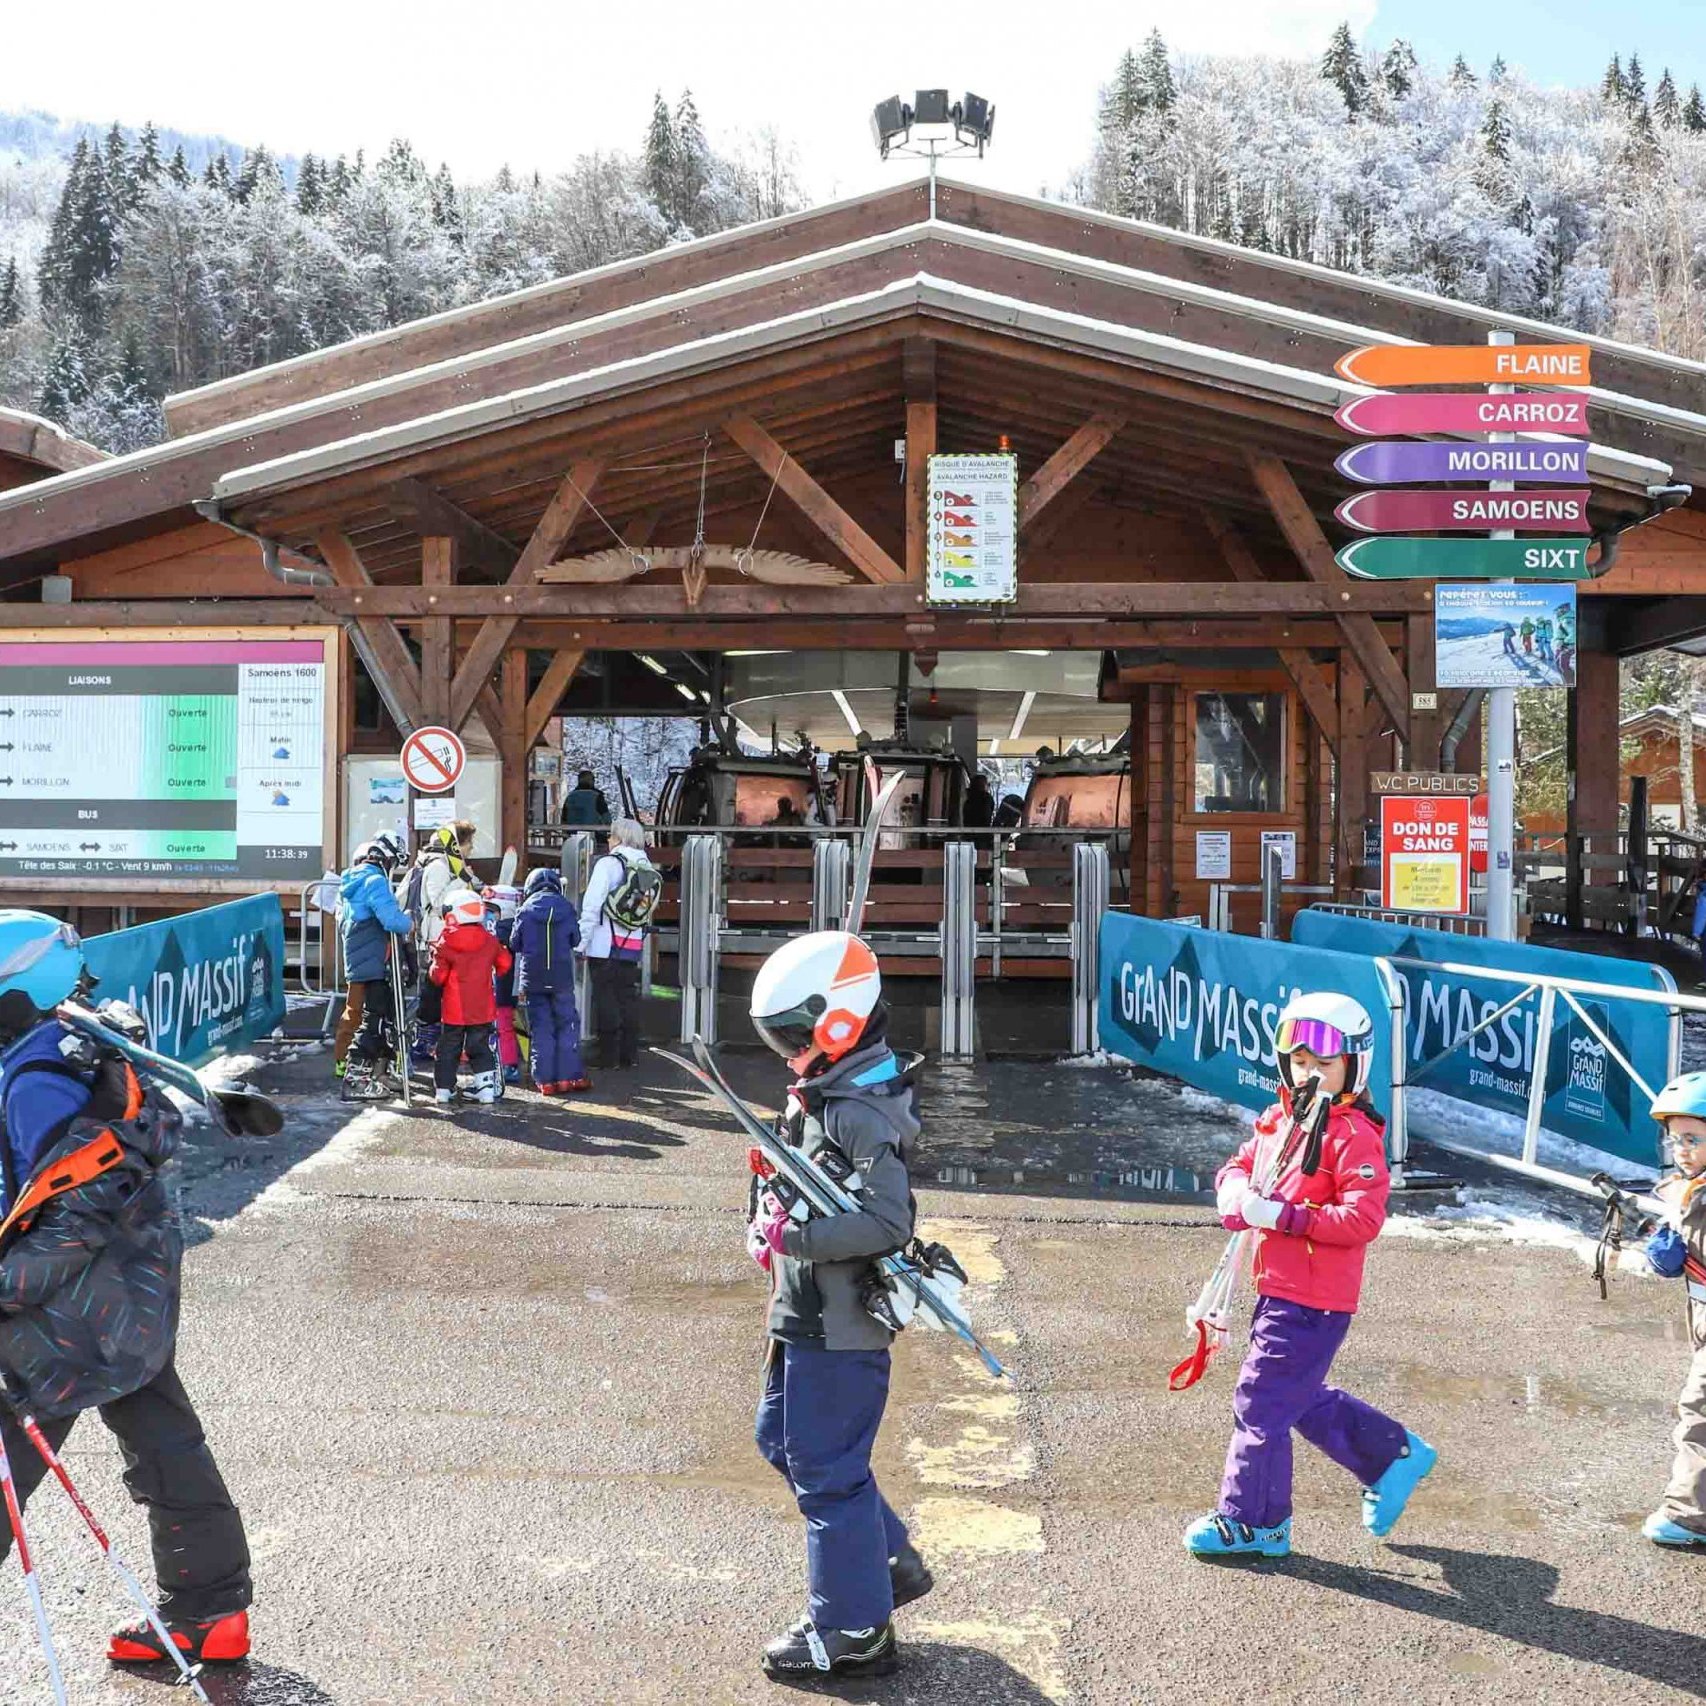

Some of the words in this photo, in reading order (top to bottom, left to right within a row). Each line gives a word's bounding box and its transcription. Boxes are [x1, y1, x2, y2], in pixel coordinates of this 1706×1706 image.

[1496, 354, 1582, 375] FLAINE
[1478, 403, 1580, 423] CARROZ
[1449, 451, 1580, 472] MORILLON
[1453, 499, 1580, 520] SAMOENS
[1524, 549, 1580, 569] SIXT
[295, 668, 317, 678] 1600
[68, 675, 112, 685] LIAISONS
[168, 708, 207, 718] Ouverte
[168, 743, 207, 753] Ouverte
[167, 777, 207, 787] Ouverte
[1376, 776, 1402, 790] WC
[1407, 776, 1479, 791] PUBLICS
[77, 809, 98, 819] BUS
[1393, 822, 1431, 835] DON
[1435, 822, 1459, 835] DE
[166, 844, 206, 853] Ouverte
[1403, 838, 1454, 851] SANG
[18, 861, 38, 870] Tête
[40, 861, 56, 870] des
[121, 861, 142, 871] Vent
[144, 861, 150, 871] 9
